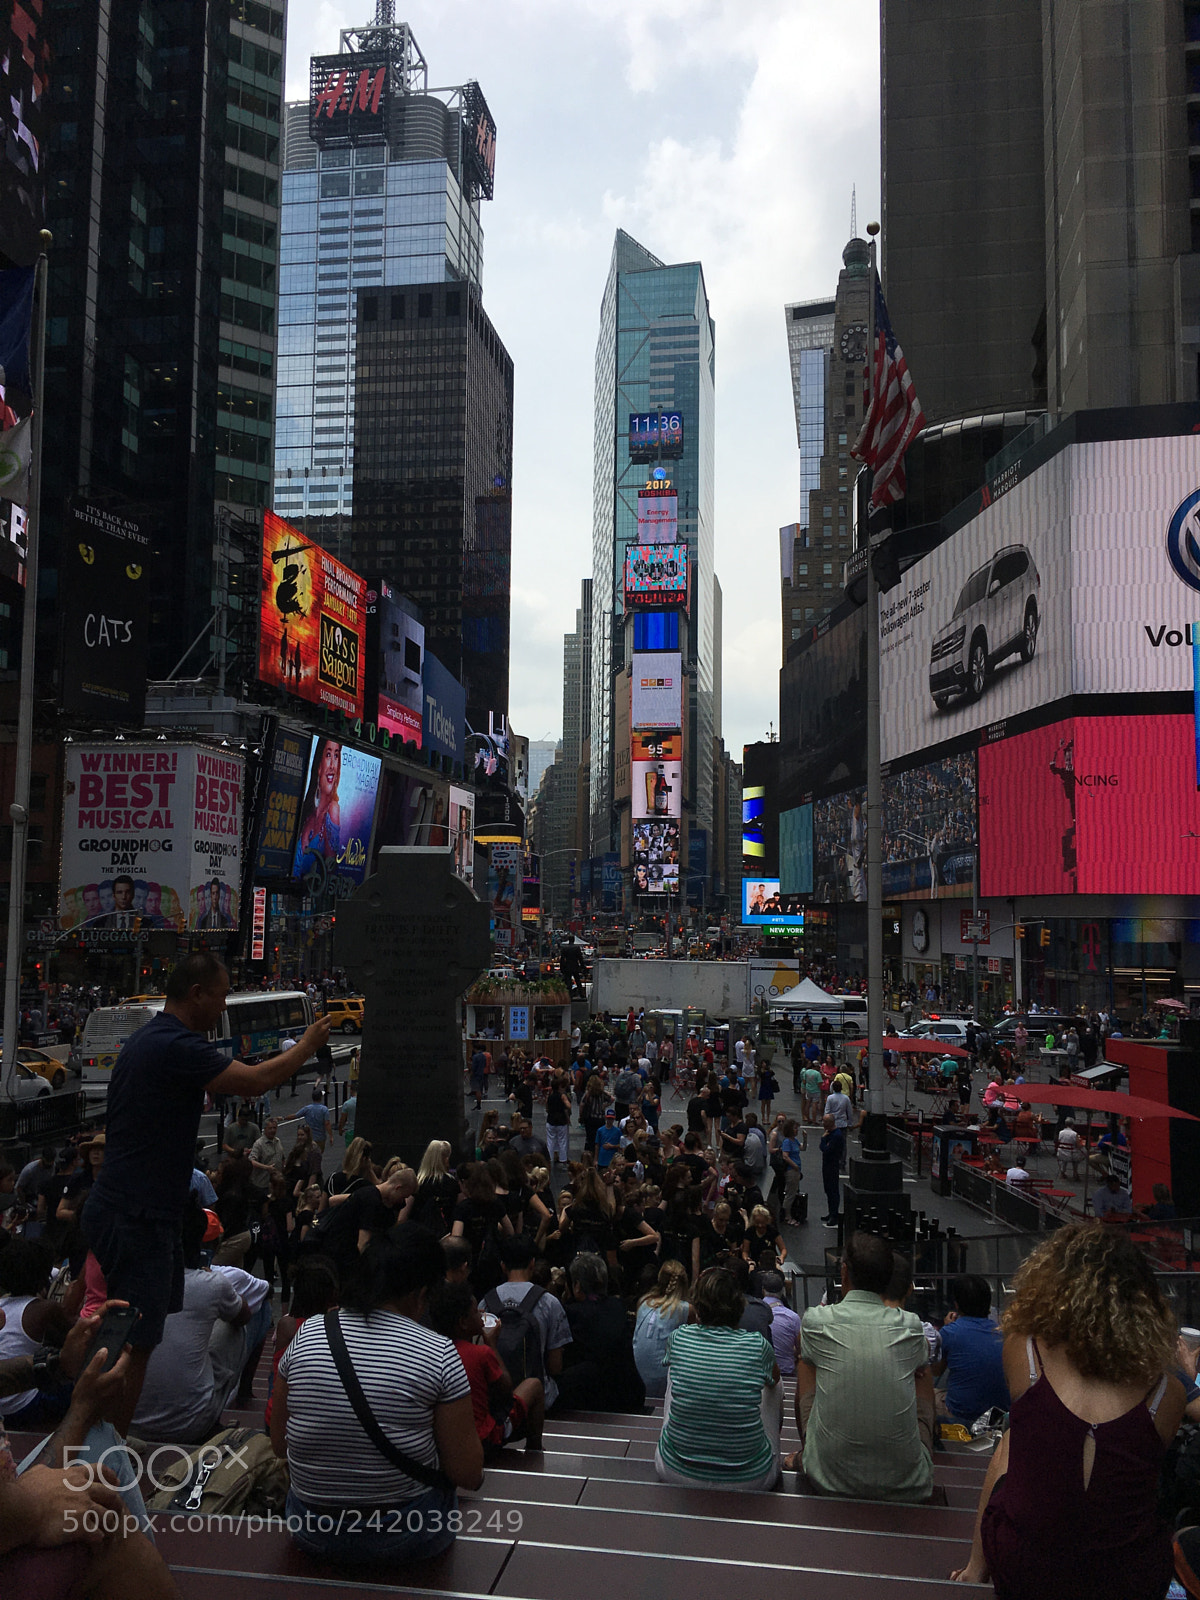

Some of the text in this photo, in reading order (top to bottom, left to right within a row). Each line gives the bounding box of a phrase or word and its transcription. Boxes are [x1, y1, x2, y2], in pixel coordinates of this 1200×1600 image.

[315, 66, 386, 119] H&M
[632, 415, 680, 432] 11:36
[993, 459, 1022, 488] MARRIOTT
[645, 480, 671, 489] 2017
[993, 474, 1018, 500] MARQUIS
[86, 504, 139, 533] IT'S BACK AND
[638, 517, 676, 525] Management
[647, 509, 669, 518] Energy
[105, 521, 127, 538] THAN
[321, 555, 361, 594] FINAL BROADWAY
[324, 575, 358, 609] PERFORMANCE
[626, 593, 685, 605] TOSHIBA
[880, 580, 931, 622] The all-new 7-seater
[323, 592, 358, 625] JANUARY 14TH
[365, 605, 377, 614] LG
[84, 613, 133, 647] CATS
[880, 611, 910, 639] Volkswagen
[321, 648, 356, 689] Saigon
[988, 721, 1007, 733] MARRIOTT
[988, 730, 1005, 740] MARQUIS
[647, 744, 663, 755] 95
[80, 753, 178, 772] WINNER!
[197, 753, 241, 783] WINNER!
[79, 773, 176, 808] BEST
[195, 775, 240, 816] BEST
[269, 790, 299, 814] COME
[78, 810, 174, 829] MUSICAL
[194, 810, 238, 836] MUSICAL
[78, 839, 173, 852] GROUNDHOG
[194, 839, 238, 857] GROUNDHOG
[262, 829, 293, 850] AWAY
[111, 852, 138, 866] DAY
[336, 837, 366, 866] Aladdin
[116, 866, 147, 874] MUSICAL
[209, 855, 223, 869] DAY
[204, 868, 226, 877] THE MUSICAL
[27, 930, 148, 942] GITS LUGGAG
[1082, 923, 1101, 970] T
